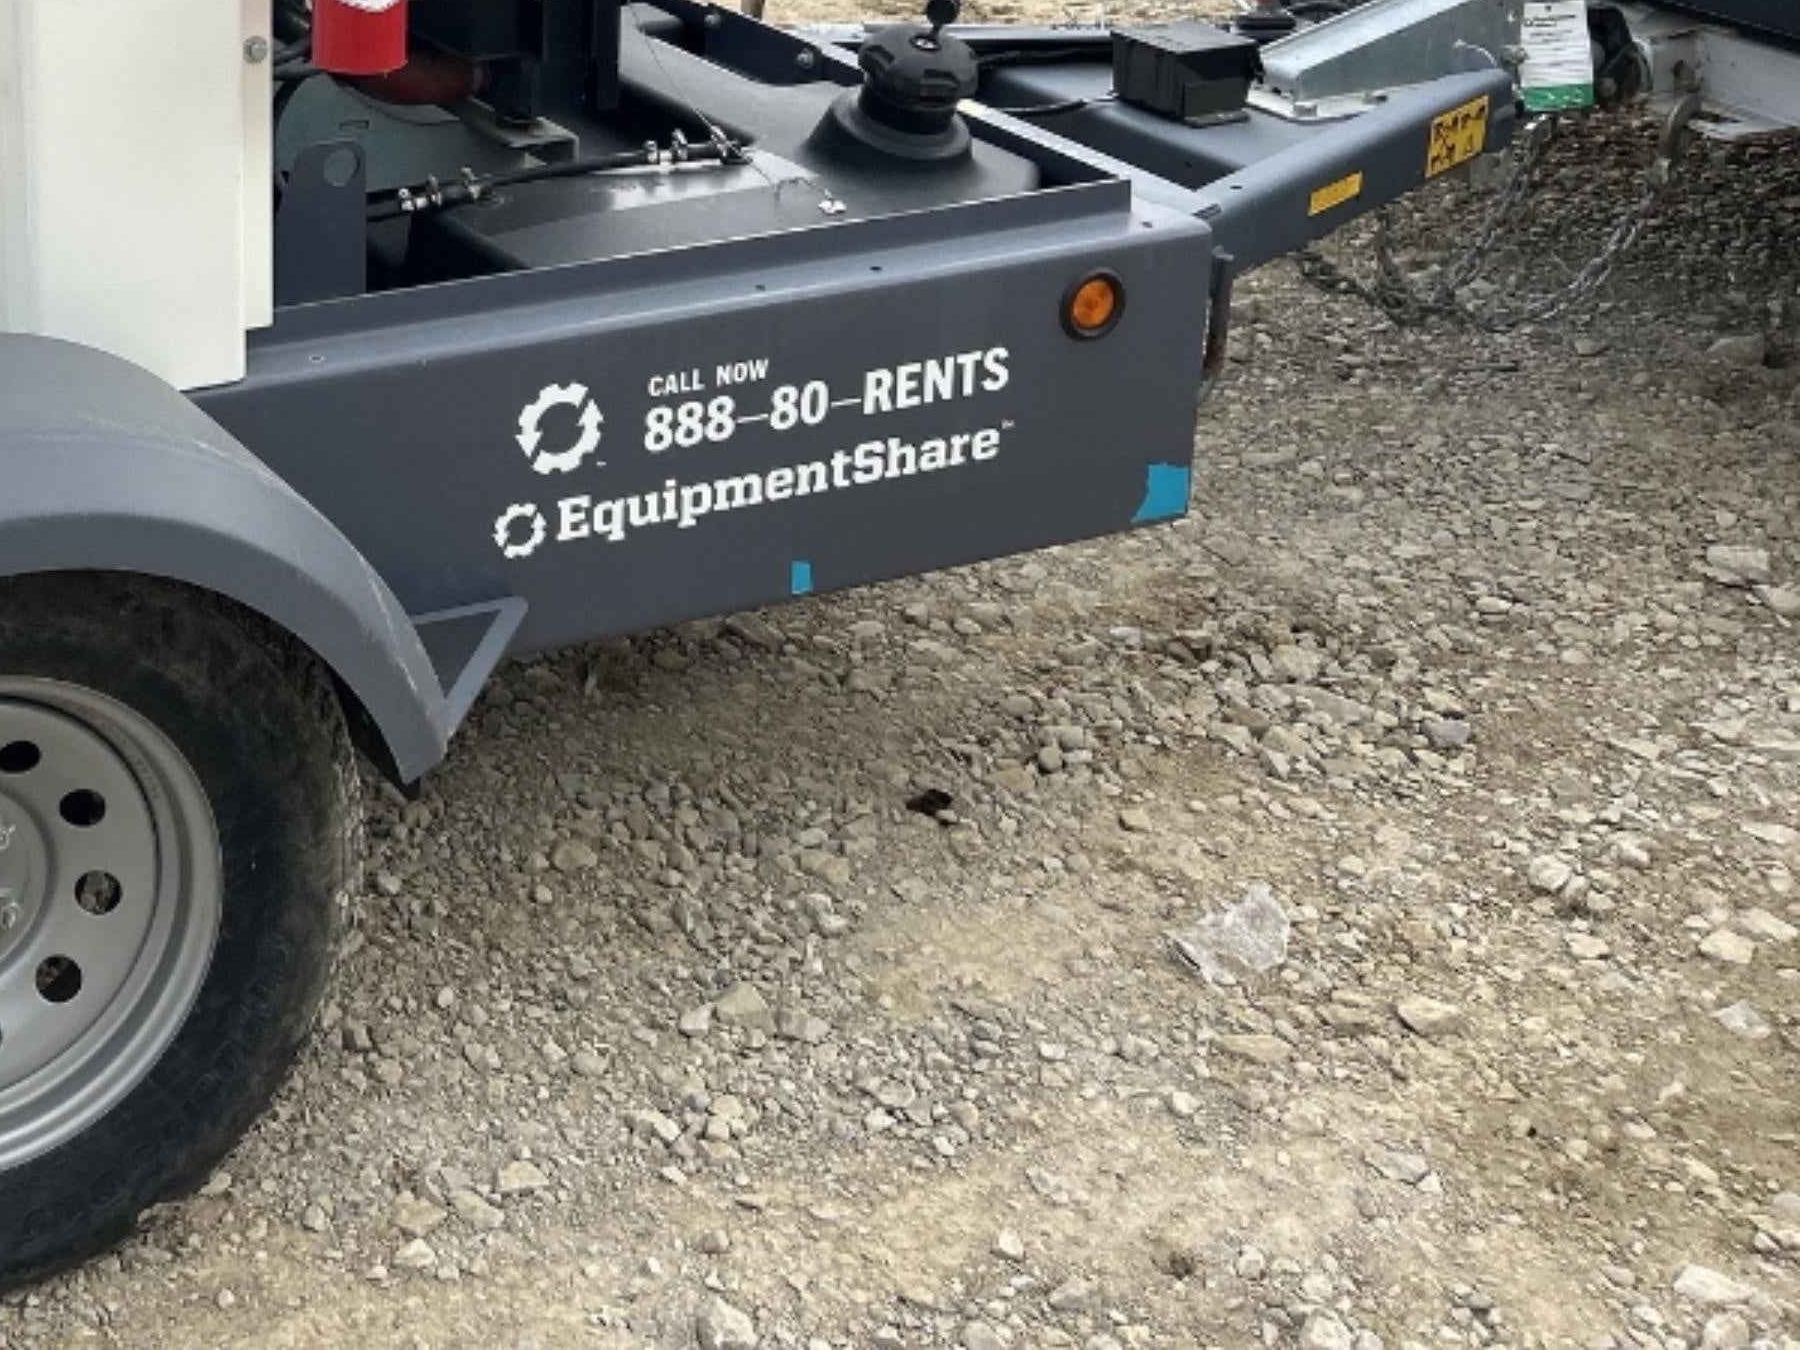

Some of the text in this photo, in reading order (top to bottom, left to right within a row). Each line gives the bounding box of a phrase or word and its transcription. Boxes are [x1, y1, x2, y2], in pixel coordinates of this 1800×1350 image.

[643, 347, 1011, 453] 888-80-RENTS
[647, 358, 770, 397] CALL NOW
